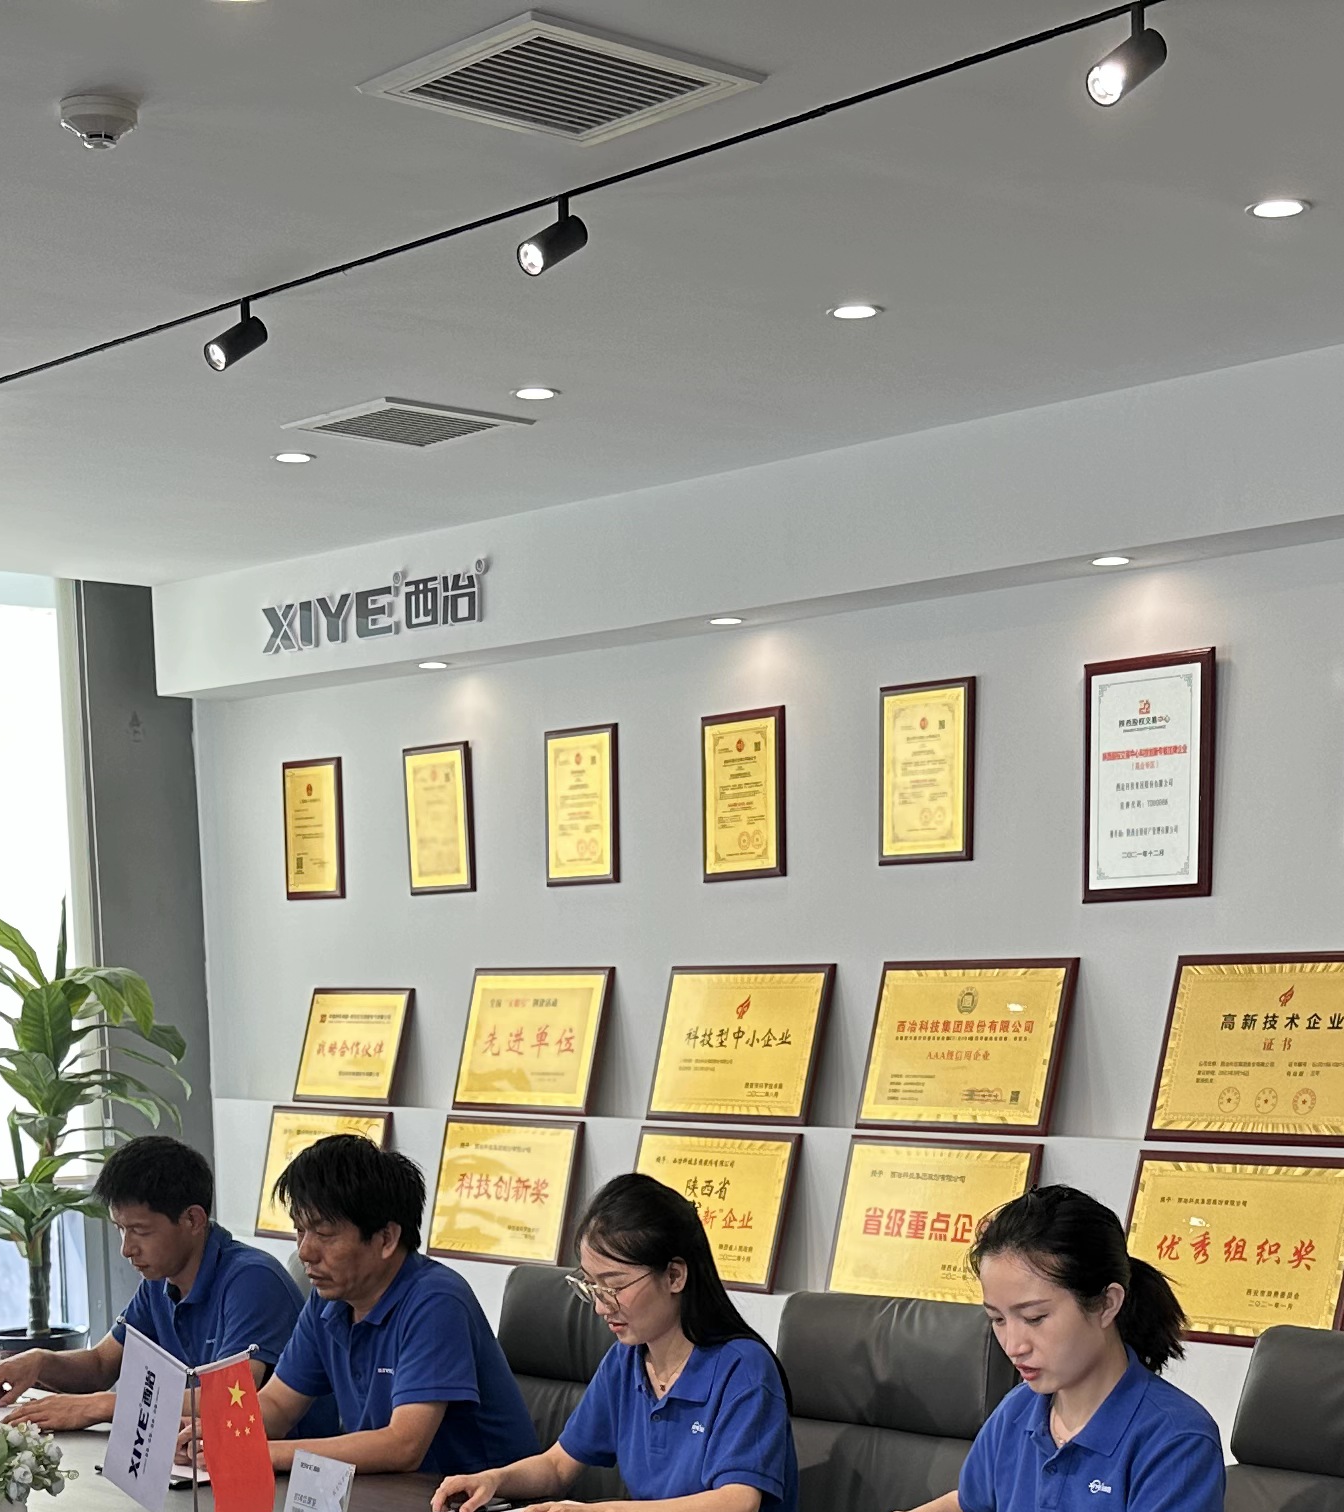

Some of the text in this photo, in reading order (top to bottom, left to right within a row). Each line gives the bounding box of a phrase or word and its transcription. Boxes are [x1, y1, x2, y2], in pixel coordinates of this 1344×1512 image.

[262, 573, 478, 654] XIYE 西冶
[482, 1024, 575, 1059] 先进单位
[685, 1025, 792, 1049] 科技型中小企业
[896, 1020, 1034, 1034] 西冶科技集团股份有限公司
[1262, 1037, 1293, 1051] 证书
[456, 1172, 549, 1204] 科技创新奖
[685, 1176, 730, 1200] 陕西省
[863, 1207, 989, 1243] 省级重点企
[1157, 1231, 1317, 1271] 优秀组织奖
[127, 1408, 150, 1479] XIYE
